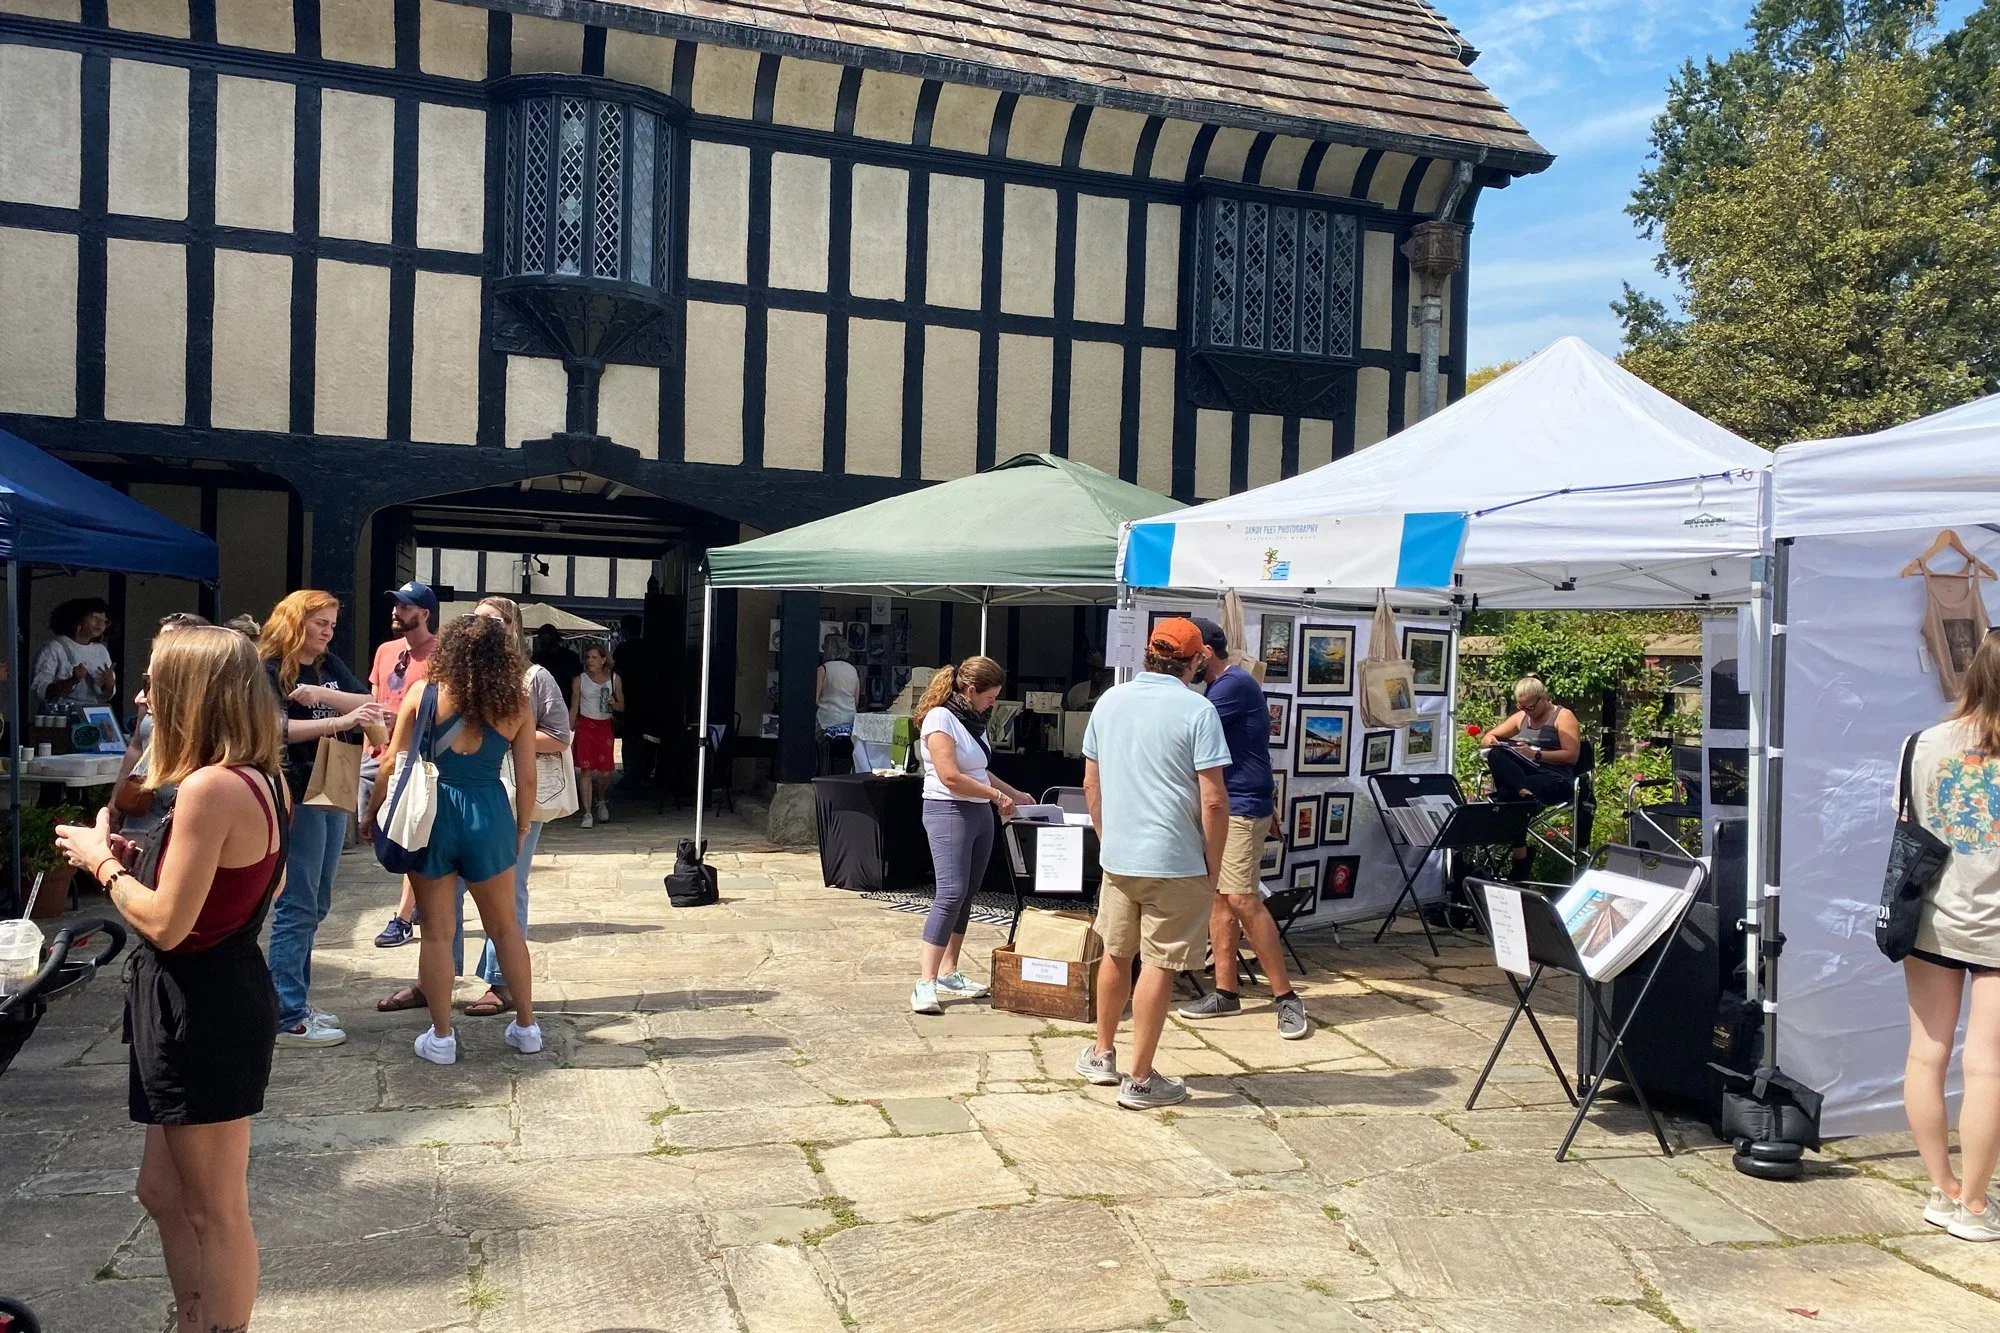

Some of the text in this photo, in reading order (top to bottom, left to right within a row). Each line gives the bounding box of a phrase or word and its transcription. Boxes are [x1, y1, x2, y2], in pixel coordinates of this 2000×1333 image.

[1263, 525, 1277, 534] FEET
[1278, 524, 1319, 534] PHOTOGRAPHY
[1130, 1084, 1151, 1095] HOKA
